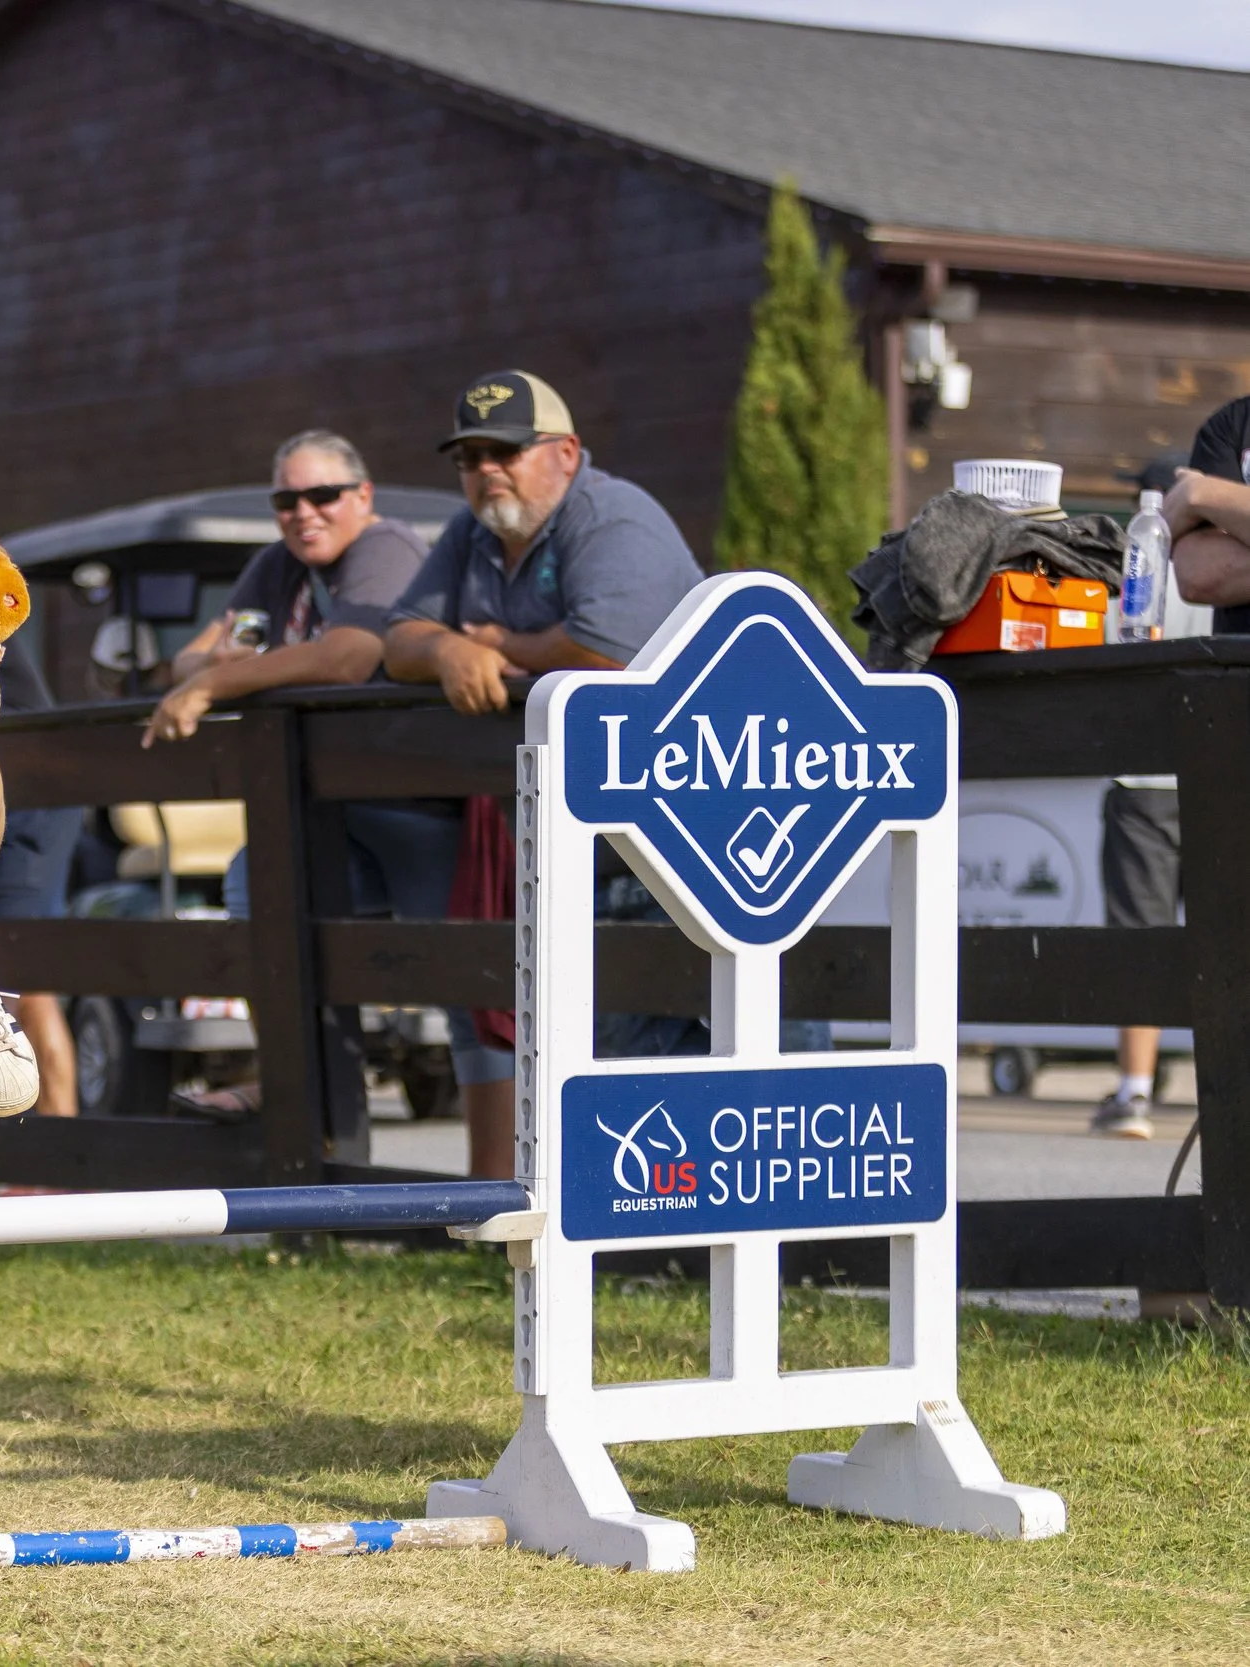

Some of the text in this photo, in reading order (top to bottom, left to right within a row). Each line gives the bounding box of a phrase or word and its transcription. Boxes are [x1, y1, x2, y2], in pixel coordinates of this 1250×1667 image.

[599, 714, 916, 791] LeMieux
[710, 1101, 914, 1153] OFFICIAL
[613, 1195, 697, 1213] EQUESTRIAN
[655, 1162, 697, 1194] US
[708, 1153, 912, 1206] SUPPLIER
